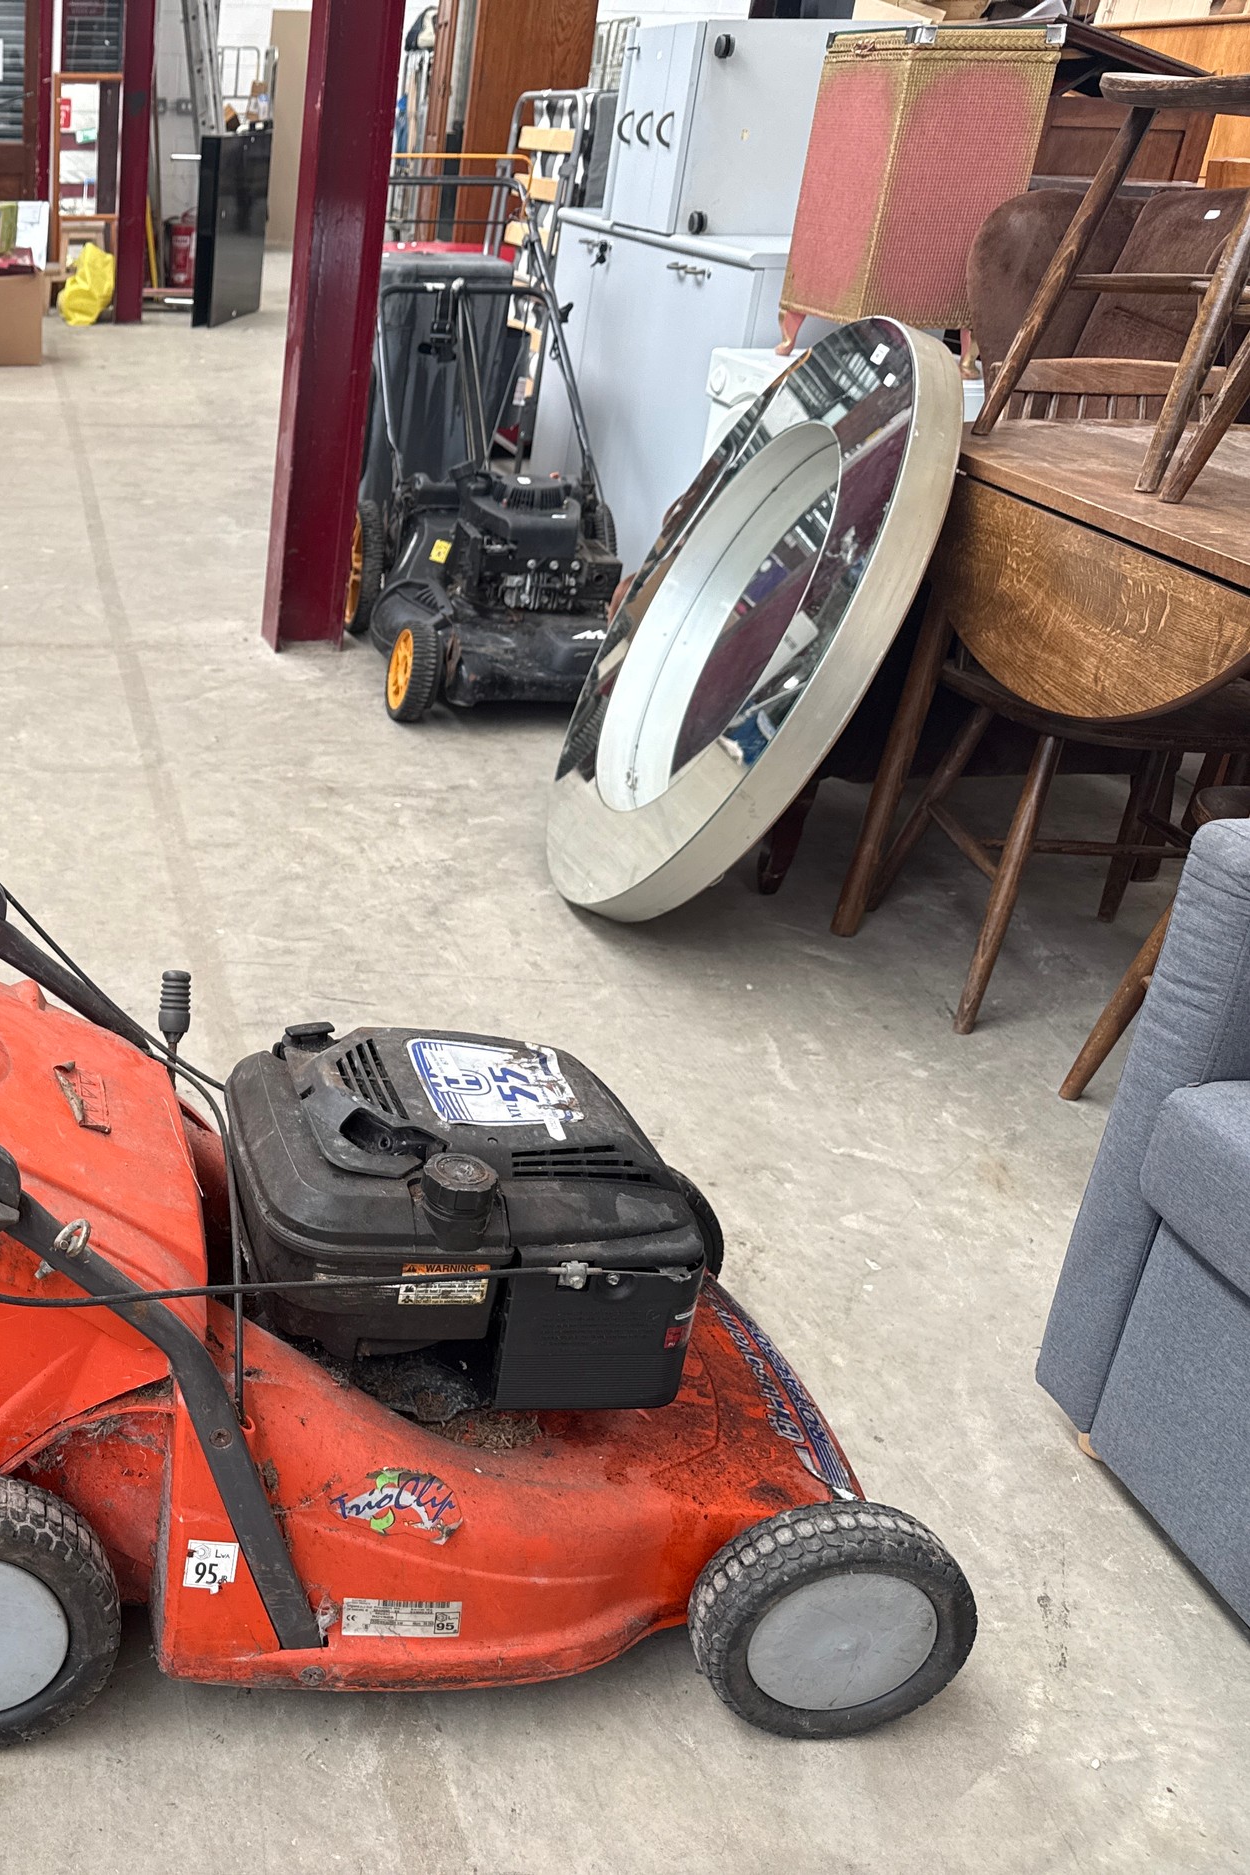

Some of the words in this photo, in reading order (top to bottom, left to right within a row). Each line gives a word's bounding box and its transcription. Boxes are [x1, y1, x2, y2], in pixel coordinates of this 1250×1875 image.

[488, 1067, 540, 1102] 55
[506, 1103, 522, 1118] XTL
[425, 1264, 476, 1273] WARNING
[775, 1363, 830, 1444] ROYAL
[194, 1562, 219, 1584] 95
[436, 1622, 455, 1631] 95
